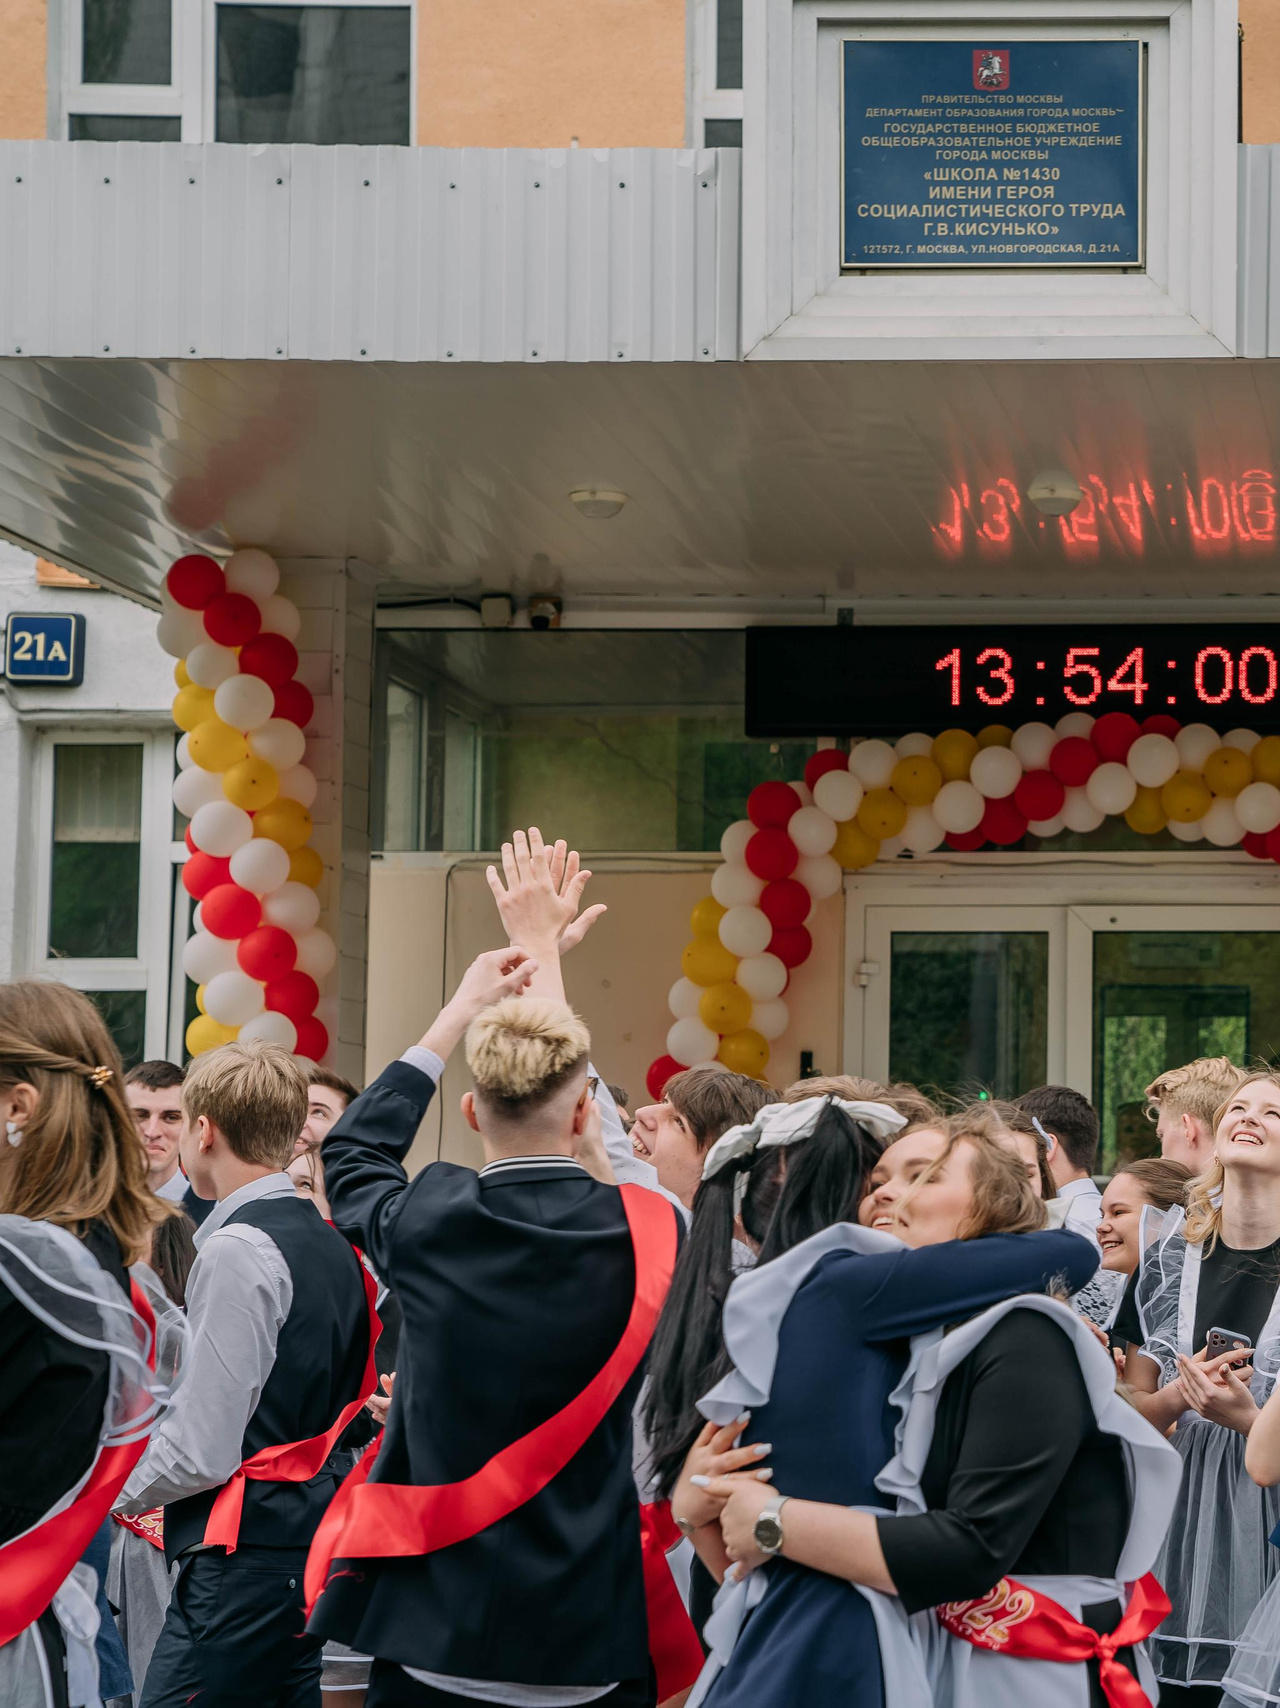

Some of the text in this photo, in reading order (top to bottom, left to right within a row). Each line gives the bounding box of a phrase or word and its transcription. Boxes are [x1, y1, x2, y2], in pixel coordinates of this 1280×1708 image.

[922, 95, 1063, 103] ПРАВИТЕЛЬСТВО МОСКВЫ
[865, 108, 943, 117] ДЕПАРТАМЕНТ
[1027, 109, 1069, 117] ГОРОДА
[884, 123, 1100, 134] ГОСУДАРСТВЕННОЕ БЮДЖЕТНОЕ
[861, 136, 1122, 147] ОБЩЕОБРАЗОВАТЕЛЬНОЕ УЧРЕЖДЕНИЕ
[935, 150, 1049, 161] ГОРОДА МОСКВЫ
[923, 168, 1061, 180] «ШКОЛА №1430
[929, 186, 1055, 199] ИМЕНИ ГЕРОЯ
[857, 203, 1126, 219] СОЦИАЛИСТИЧЕСКОГО ТРУДА
[923, 222, 1060, 236] Г.В.КИСУНЬКО»
[863, 245, 903, 253] 127572,
[917, 244, 968, 254] МОСКВА,
[971, 244, 1086, 254] УЛ.НОВГОРОДСКАЯ,
[1087, 244, 1120, 253] Д.21А
[13, 631, 67, 661] 21А
[935, 646, 1278, 705] 13:54:00
